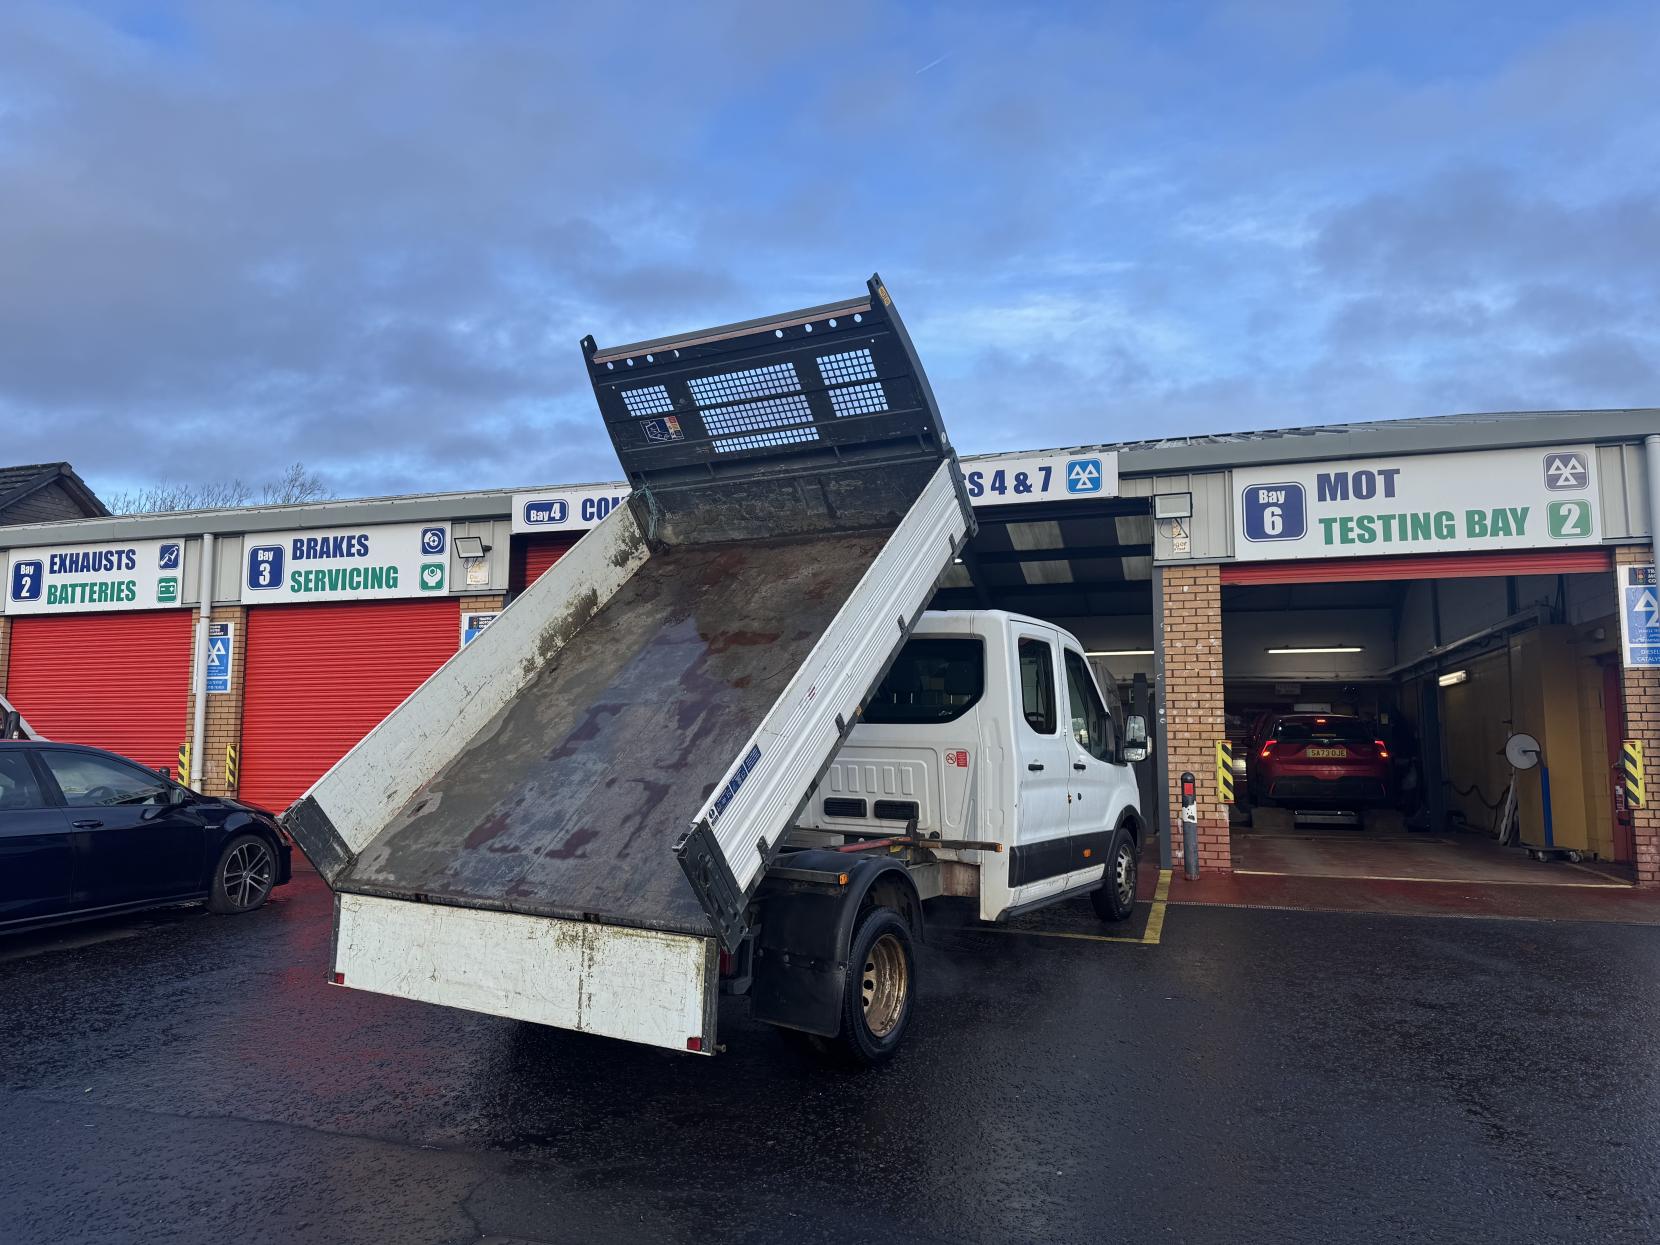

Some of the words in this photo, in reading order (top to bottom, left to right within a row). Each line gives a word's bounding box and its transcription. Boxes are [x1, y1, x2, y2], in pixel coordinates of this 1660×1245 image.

[962, 471, 985, 498] S
[990, 469, 1008, 496] 4
[1013, 471, 1033, 494] &
[1038, 466, 1053, 492] 7
[1316, 468, 1401, 502] MOT
[1258, 489, 1286, 505] Bay
[530, 510, 550, 522] Bay
[550, 502, 561, 520] 4
[1263, 506, 1283, 536] 6
[1559, 503, 1582, 535] 2
[1318, 510, 1457, 545] TESTING
[1465, 507, 1531, 539] BAY
[257, 549, 274, 562] Bay
[291, 533, 369, 561] BRAKES
[20, 564, 35, 576] Bay
[49, 548, 136, 575] EXHAUSTS
[258, 562, 271, 586] 3
[20, 576, 31, 597] 2
[47, 579, 137, 605] BATTERIES
[290, 565, 399, 593] SERVICING
